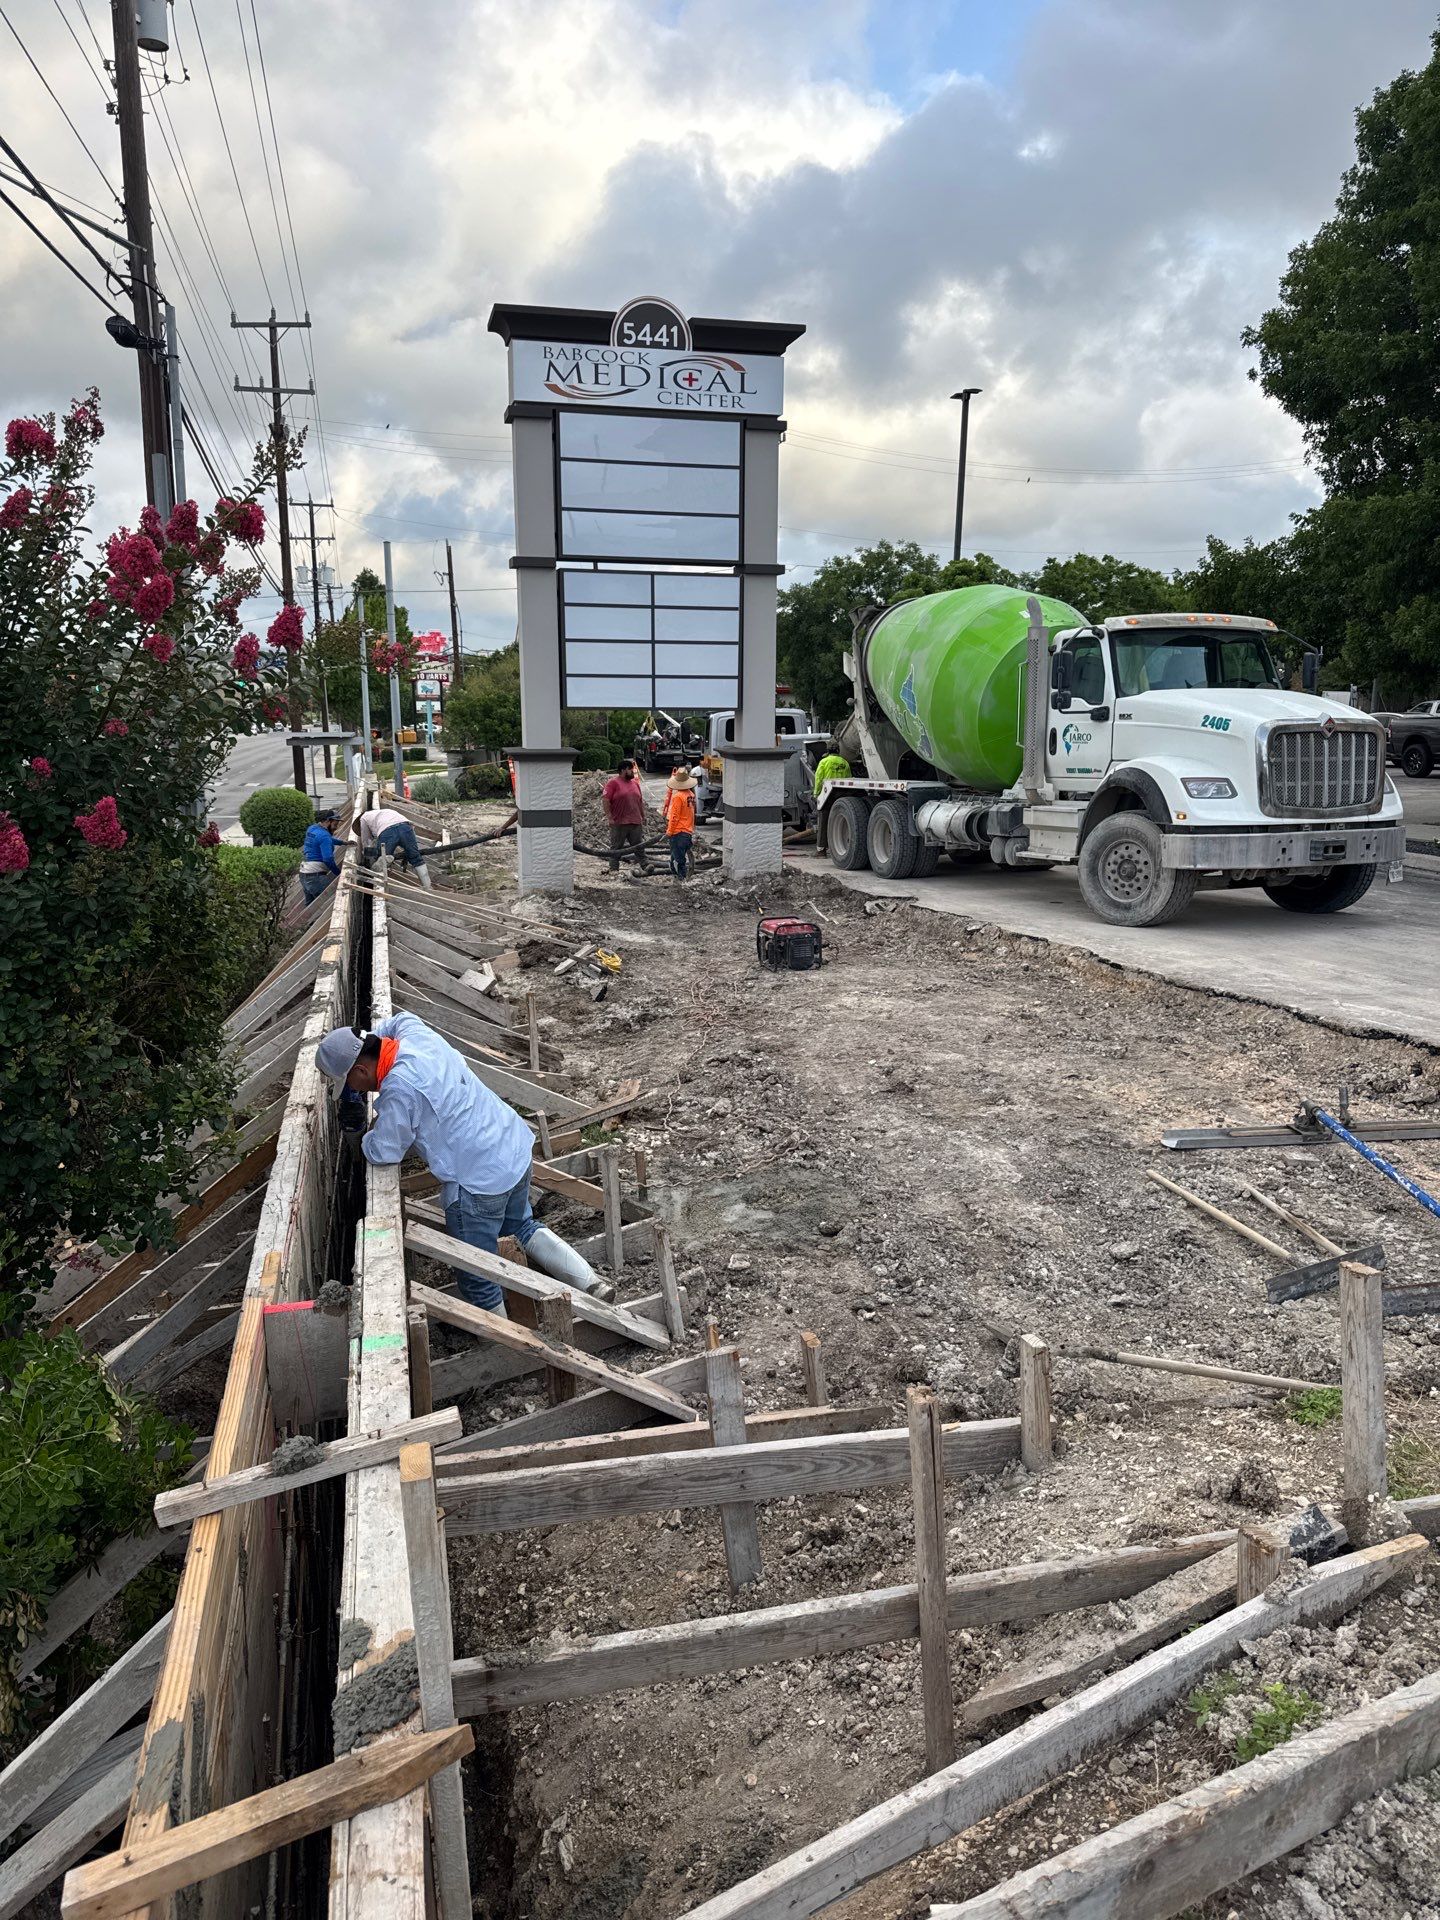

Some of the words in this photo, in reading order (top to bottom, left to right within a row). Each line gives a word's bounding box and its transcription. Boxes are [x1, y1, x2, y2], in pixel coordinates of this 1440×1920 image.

[622, 322, 678, 347] 5441
[542, 346, 652, 365] BABCOCK
[544, 360, 758, 394] MEDICAL
[657, 391, 745, 409] CENTER
[1201, 714, 1232, 731] 2405
[1069, 733, 1092, 742] JARCO
